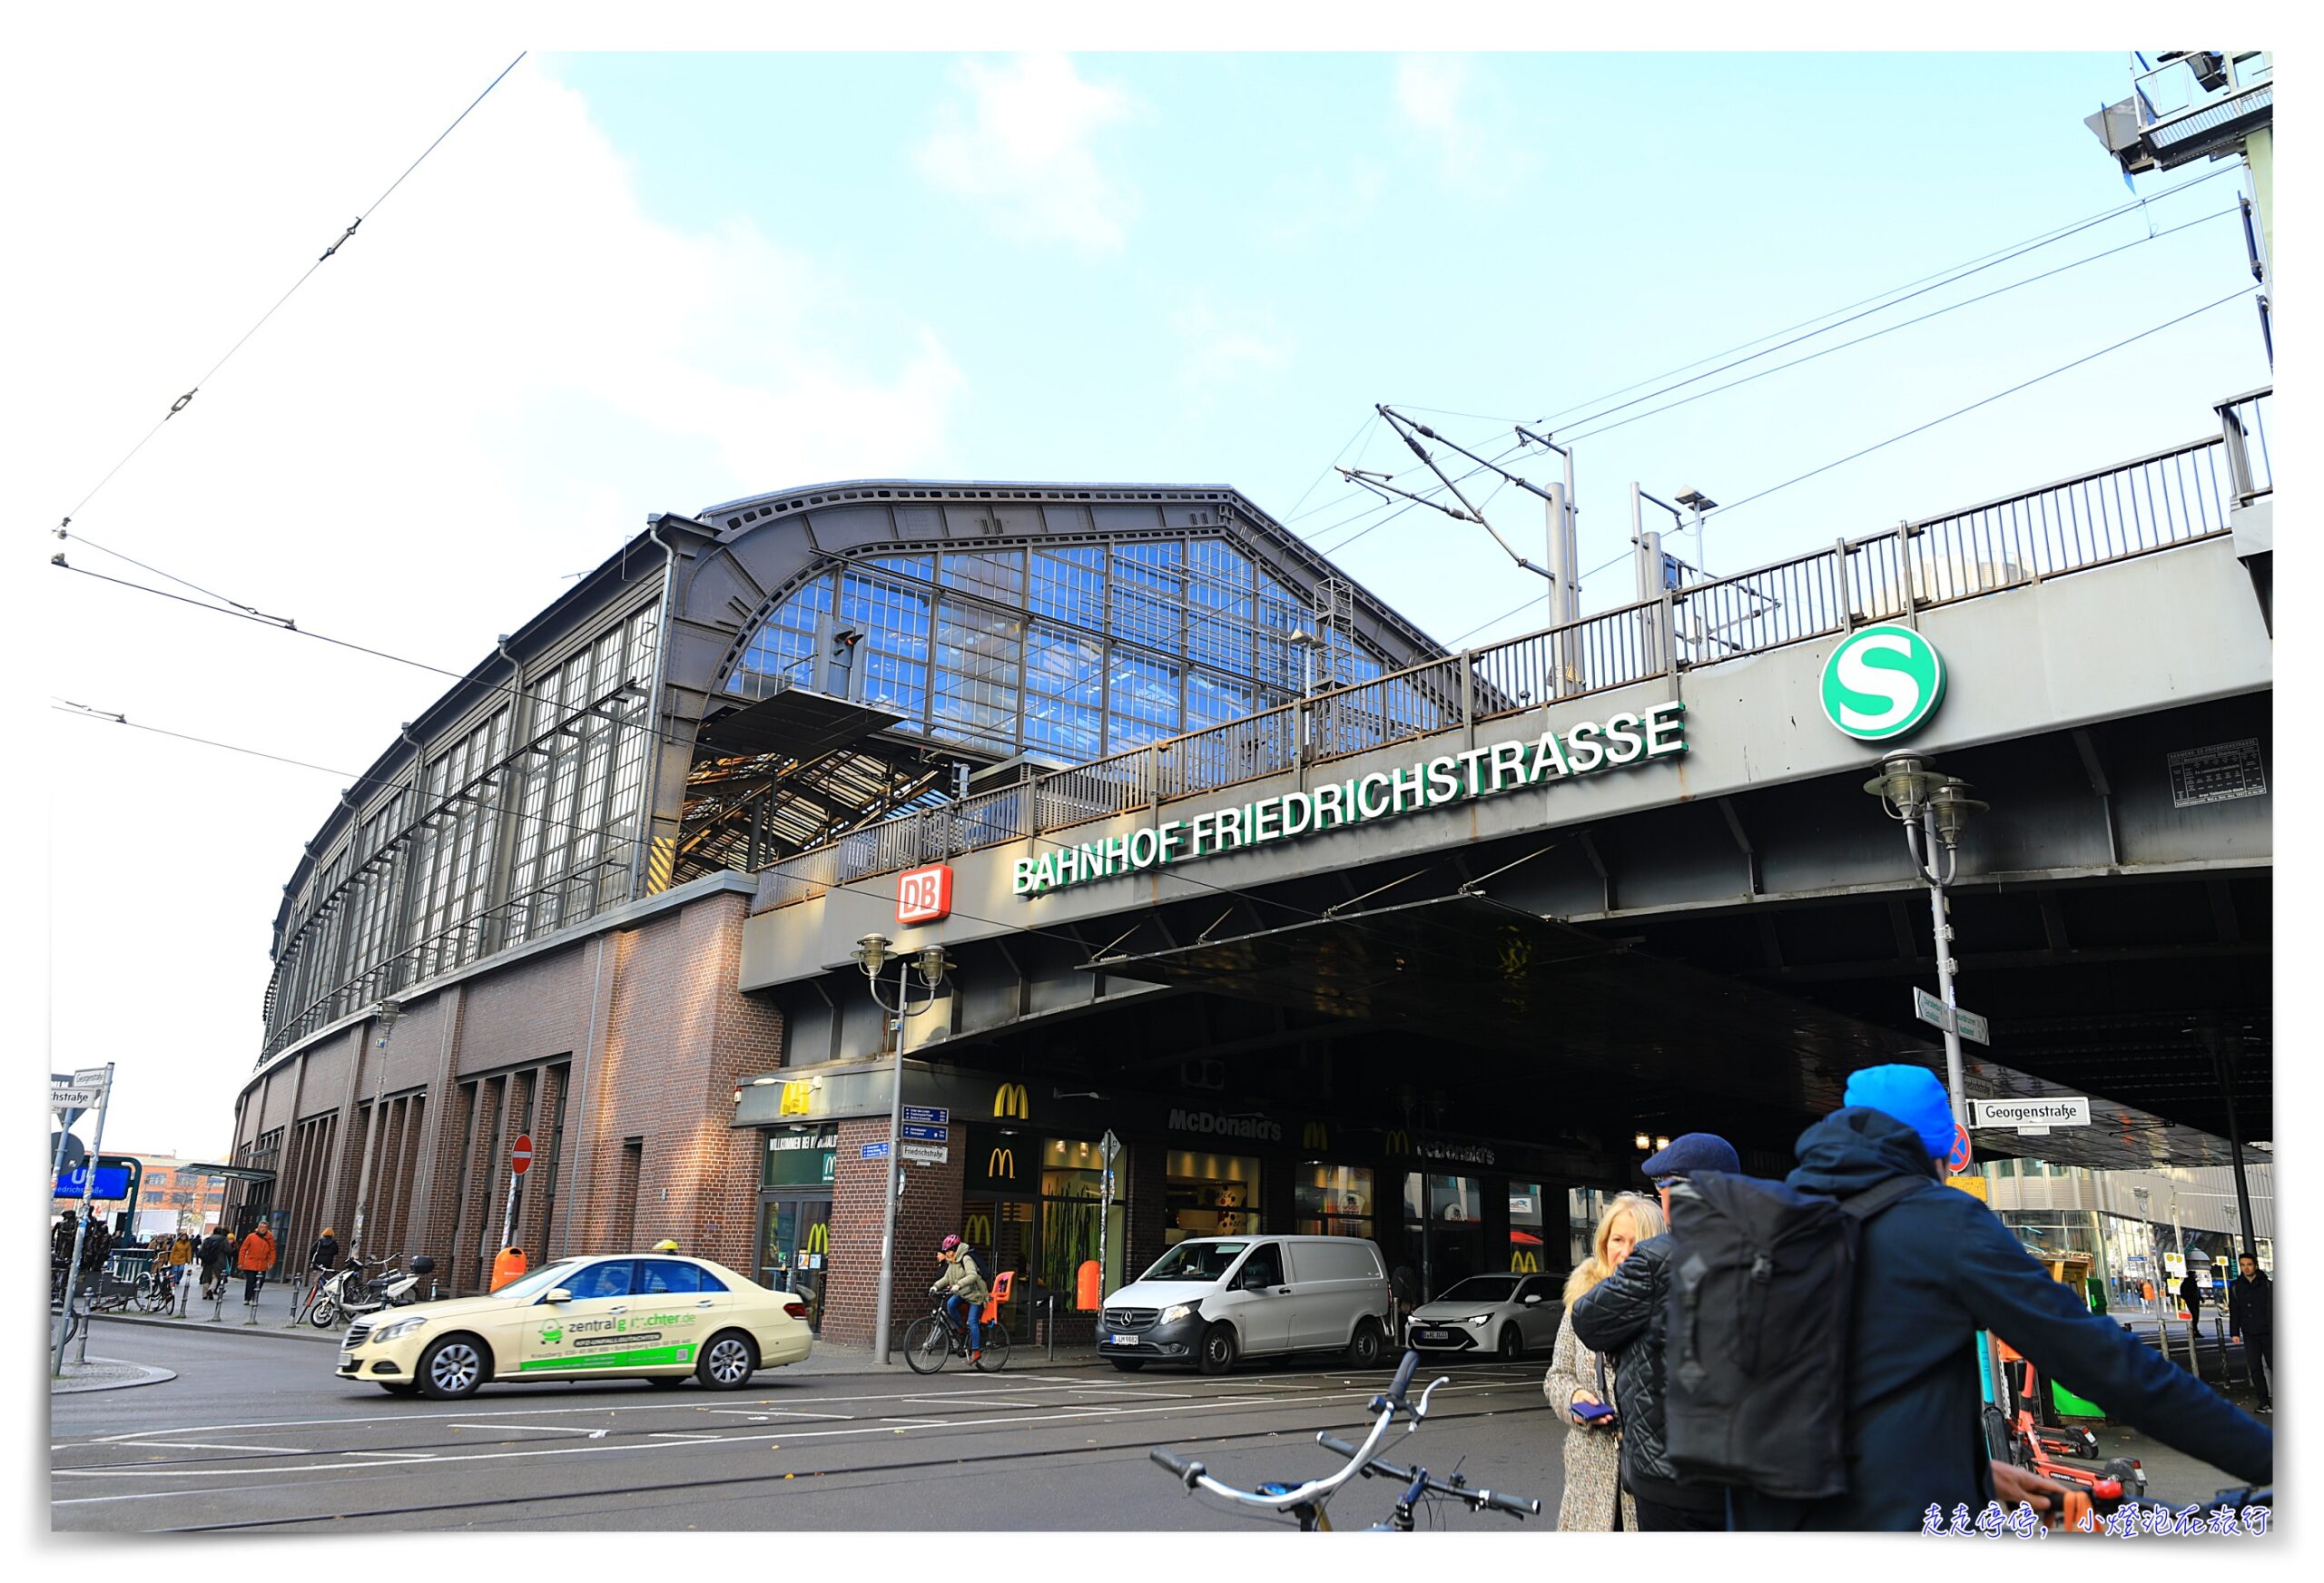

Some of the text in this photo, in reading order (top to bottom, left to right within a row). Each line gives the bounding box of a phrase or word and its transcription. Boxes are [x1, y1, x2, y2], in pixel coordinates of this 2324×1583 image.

[1836, 634, 1920, 731] S
[1012, 700, 1687, 895] BAHNHOF FRIEDRICHSTRASSE
[903, 875, 936, 914] DB
[1167, 1107, 1282, 1142] McDonald's
[1985, 1104, 2077, 1121] Georgenstraße
[769, 1136, 802, 1151] WILLKOMMEN
[802, 1136, 811, 1150] BEI
[904, 1146, 943, 1159] Friedrichstraße
